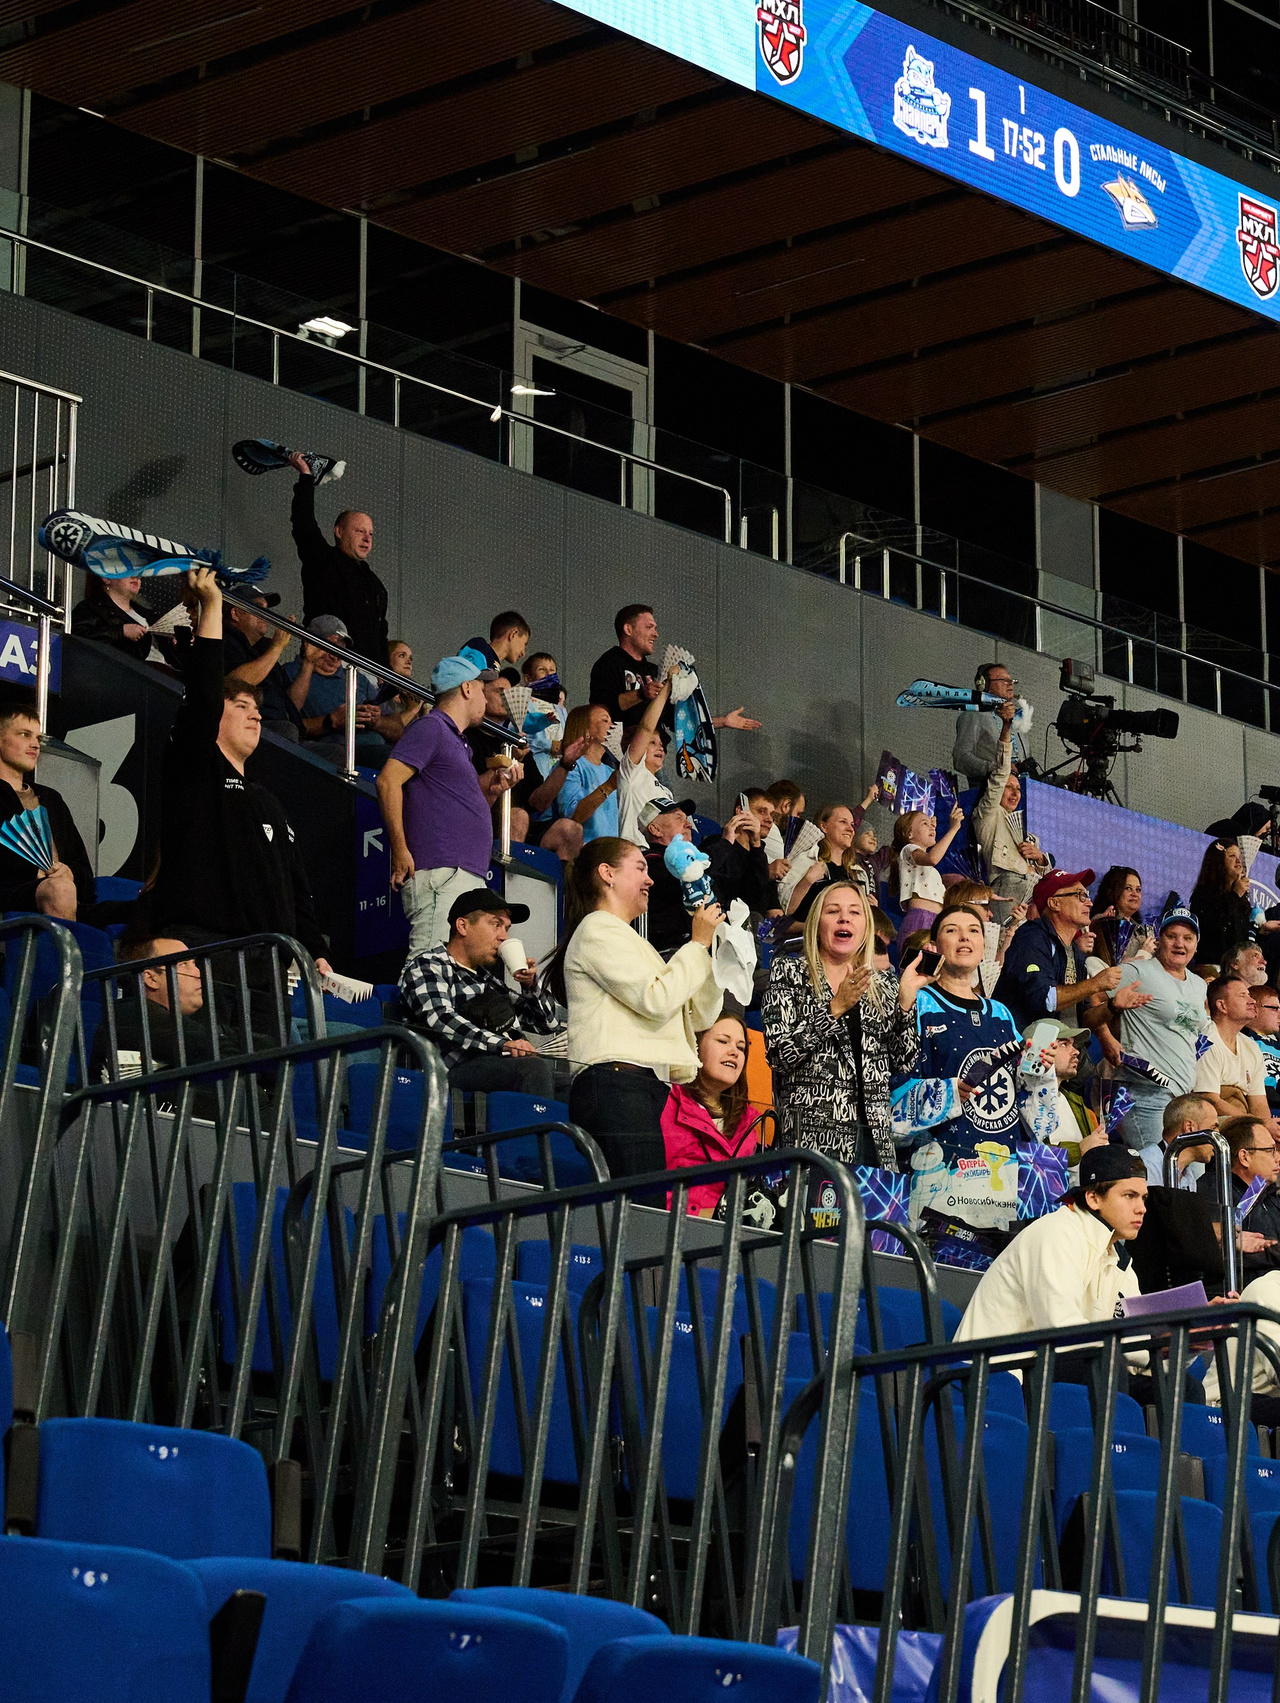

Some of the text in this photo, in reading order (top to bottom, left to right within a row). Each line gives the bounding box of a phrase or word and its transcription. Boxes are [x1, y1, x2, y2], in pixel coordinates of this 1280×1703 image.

[1018, 85, 1026, 115] 1
[968, 87, 995, 162] 1
[1002, 117, 1046, 171] 17:52
[1053, 127, 1081, 198] 0
[1090, 144, 1167, 194] СТАЛЬНЫЕ ЛИСЫ
[1242, 215, 1275, 246] МХЛ
[359, 900, 368, 912] 11
[376, 895, 387, 907] 16
[158, 1445, 169, 1460] 9
[82, 1570, 97, 1588] 6
[459, 1634, 471, 1650] 7
